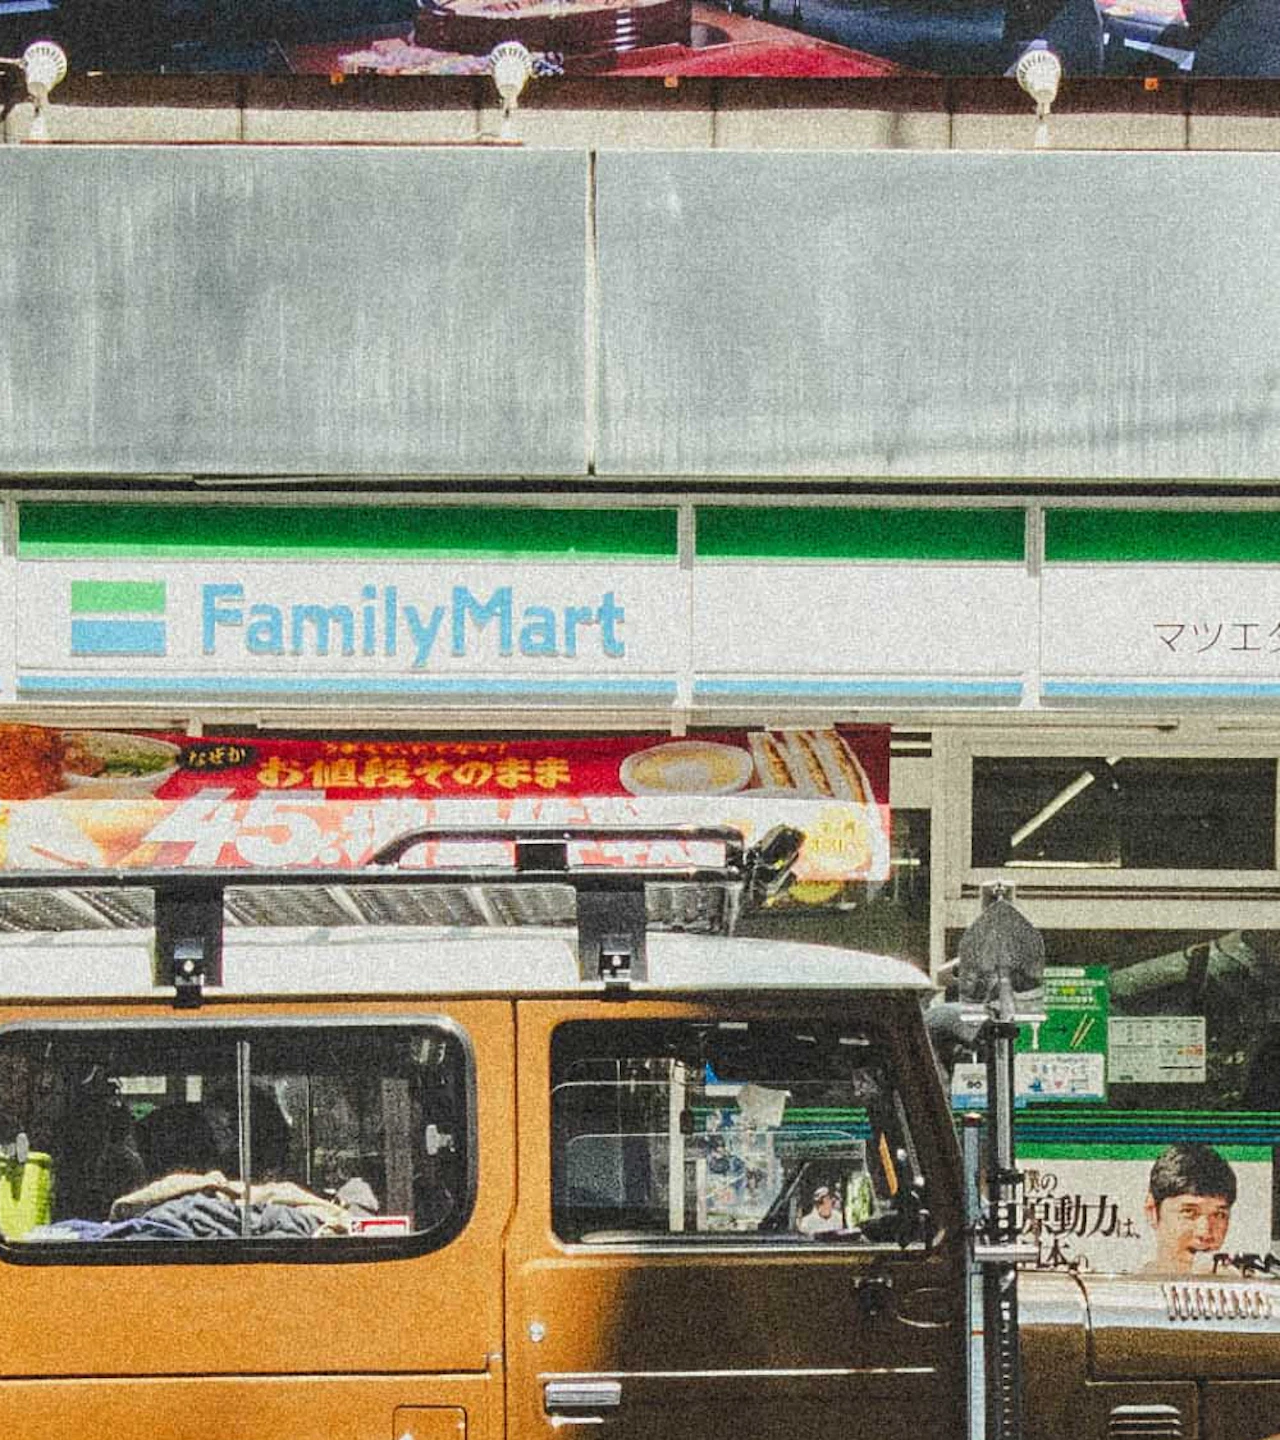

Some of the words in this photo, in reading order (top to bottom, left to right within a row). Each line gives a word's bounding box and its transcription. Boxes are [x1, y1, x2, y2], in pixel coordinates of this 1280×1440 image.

[201, 582, 625, 669] FamilyMart
[256, 756, 573, 789] お値段そのまま
